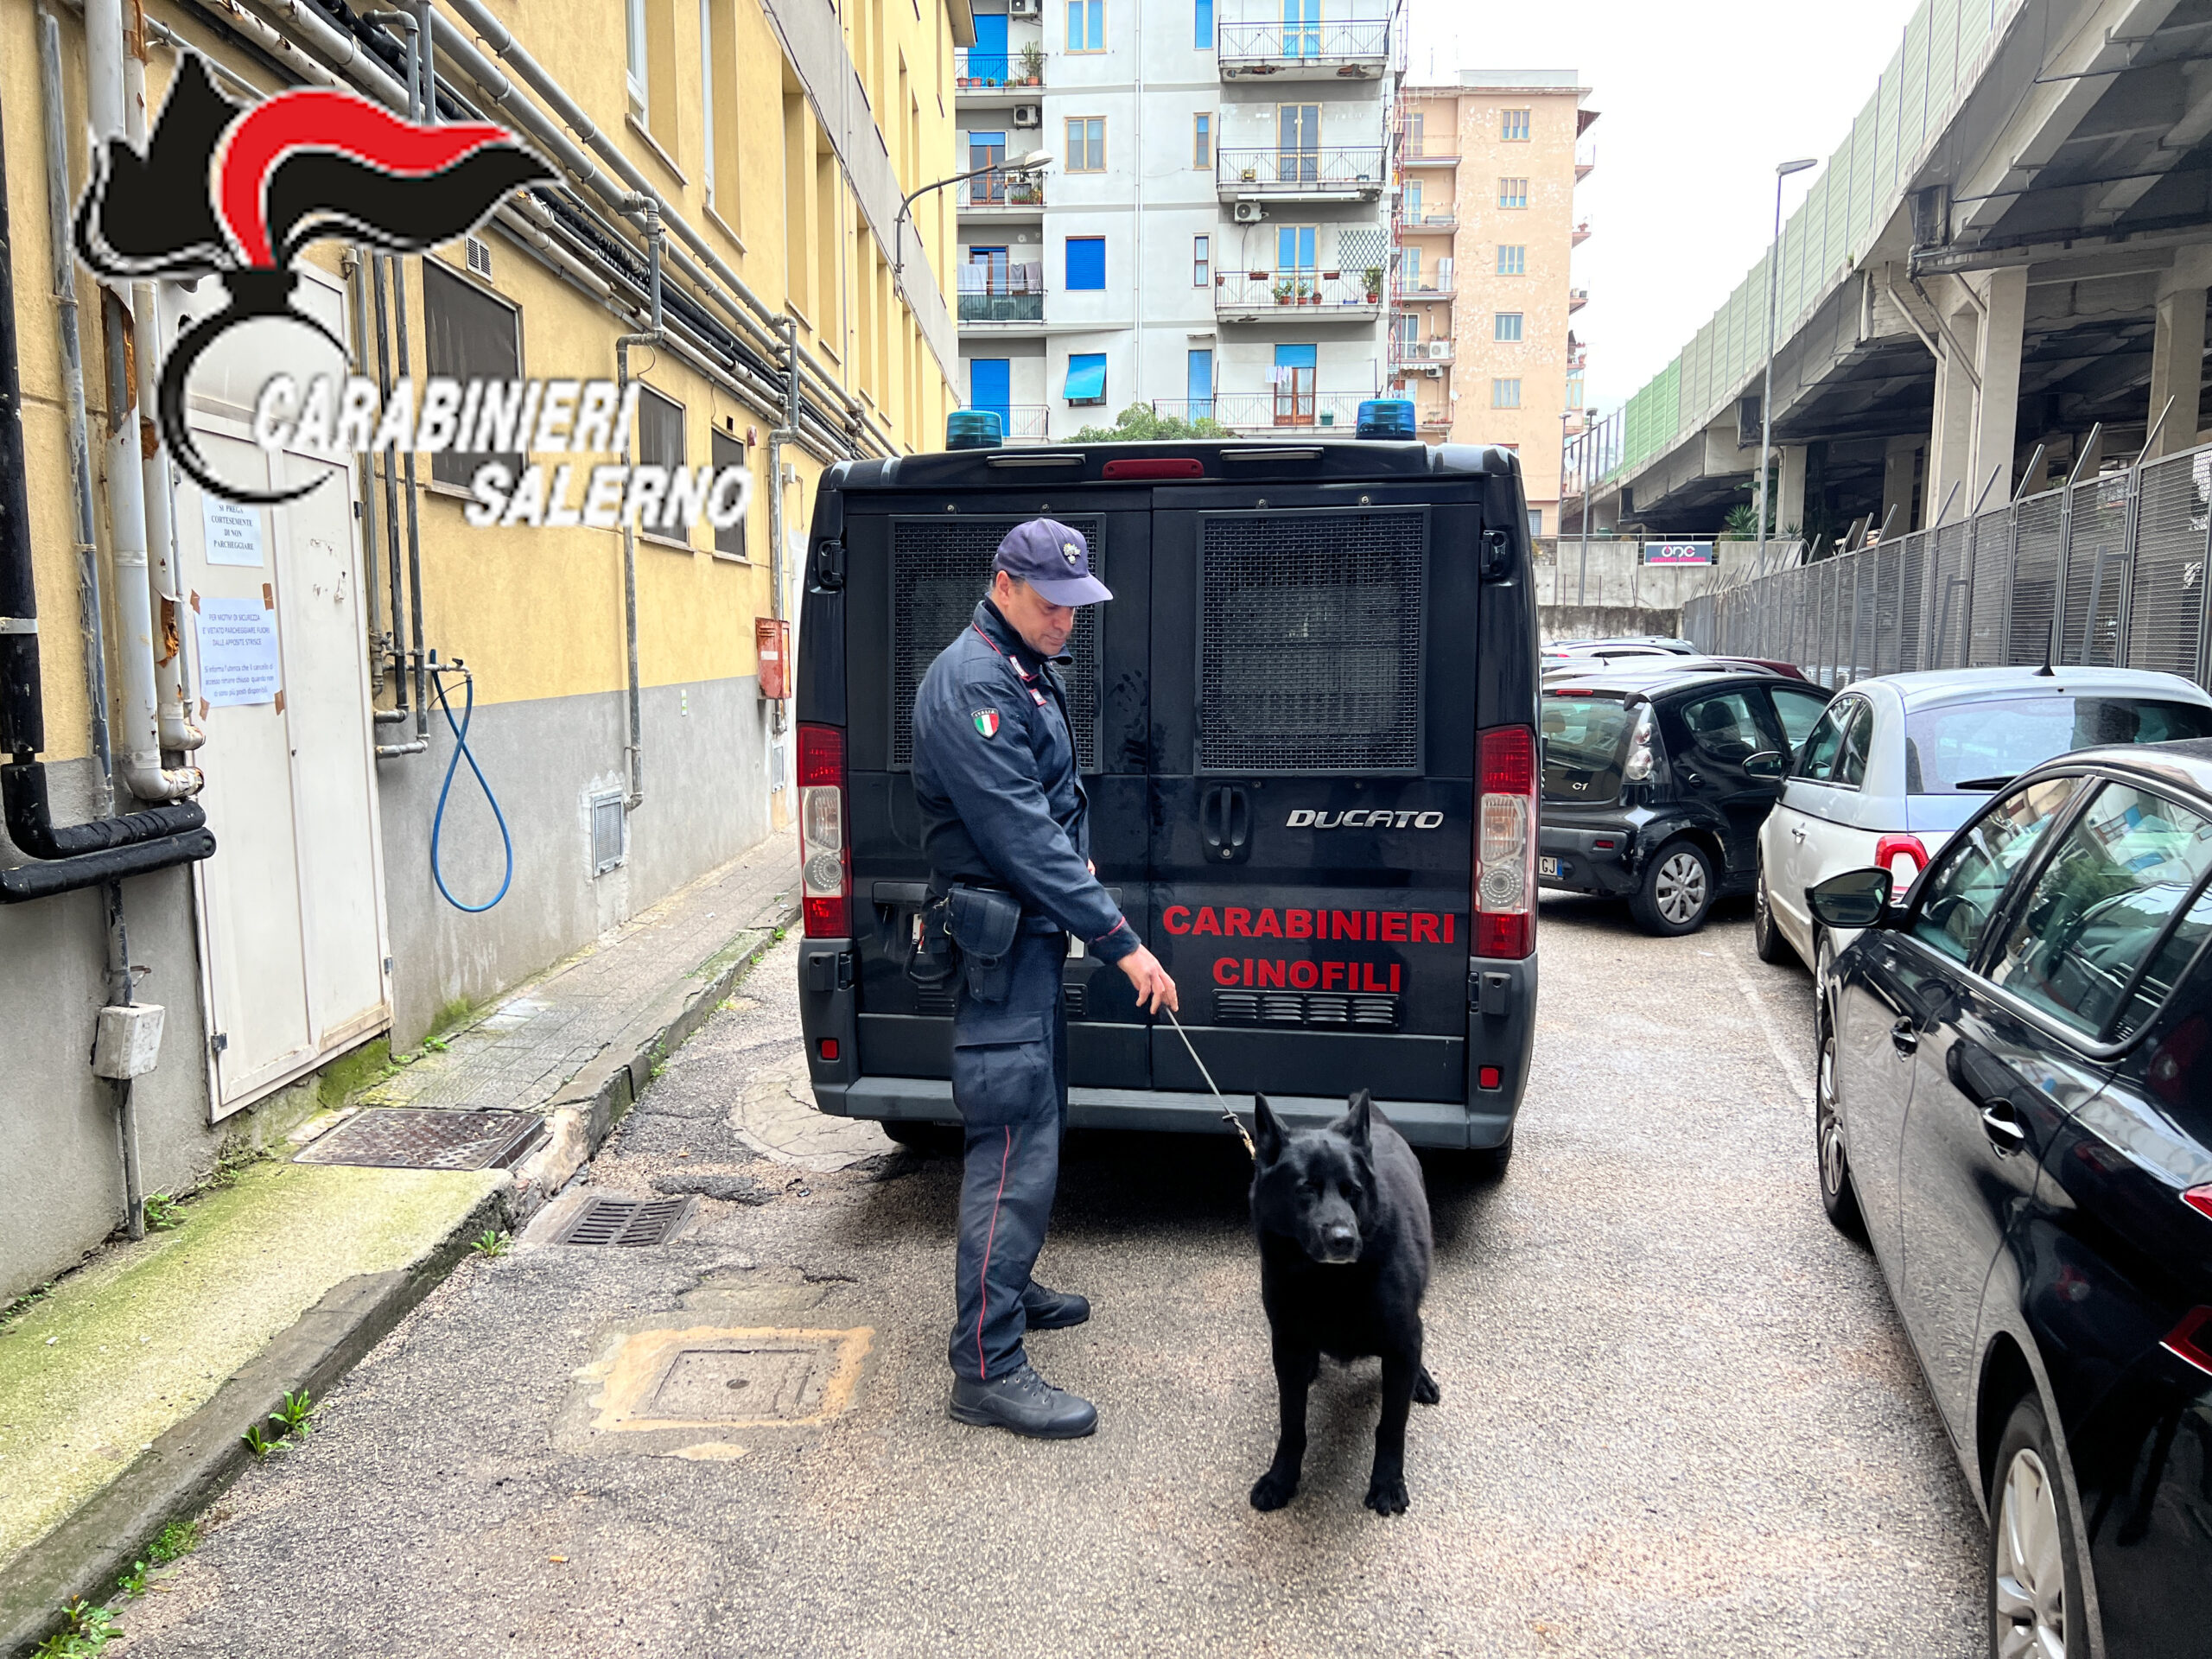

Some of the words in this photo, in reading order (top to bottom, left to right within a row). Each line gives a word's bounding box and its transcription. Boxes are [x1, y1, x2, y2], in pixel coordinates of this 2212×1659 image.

[211, 515, 253, 526] CORTESEMENTE
[213, 539, 255, 550] PARCHEGGIARE
[1573, 782, 1589, 791] C1
[1286, 810, 1445, 829] DUCATO
[1541, 858, 1555, 874] GJ
[1162, 905, 1455, 944] CARABINIERI
[1212, 957, 1401, 993] CINOFILI
